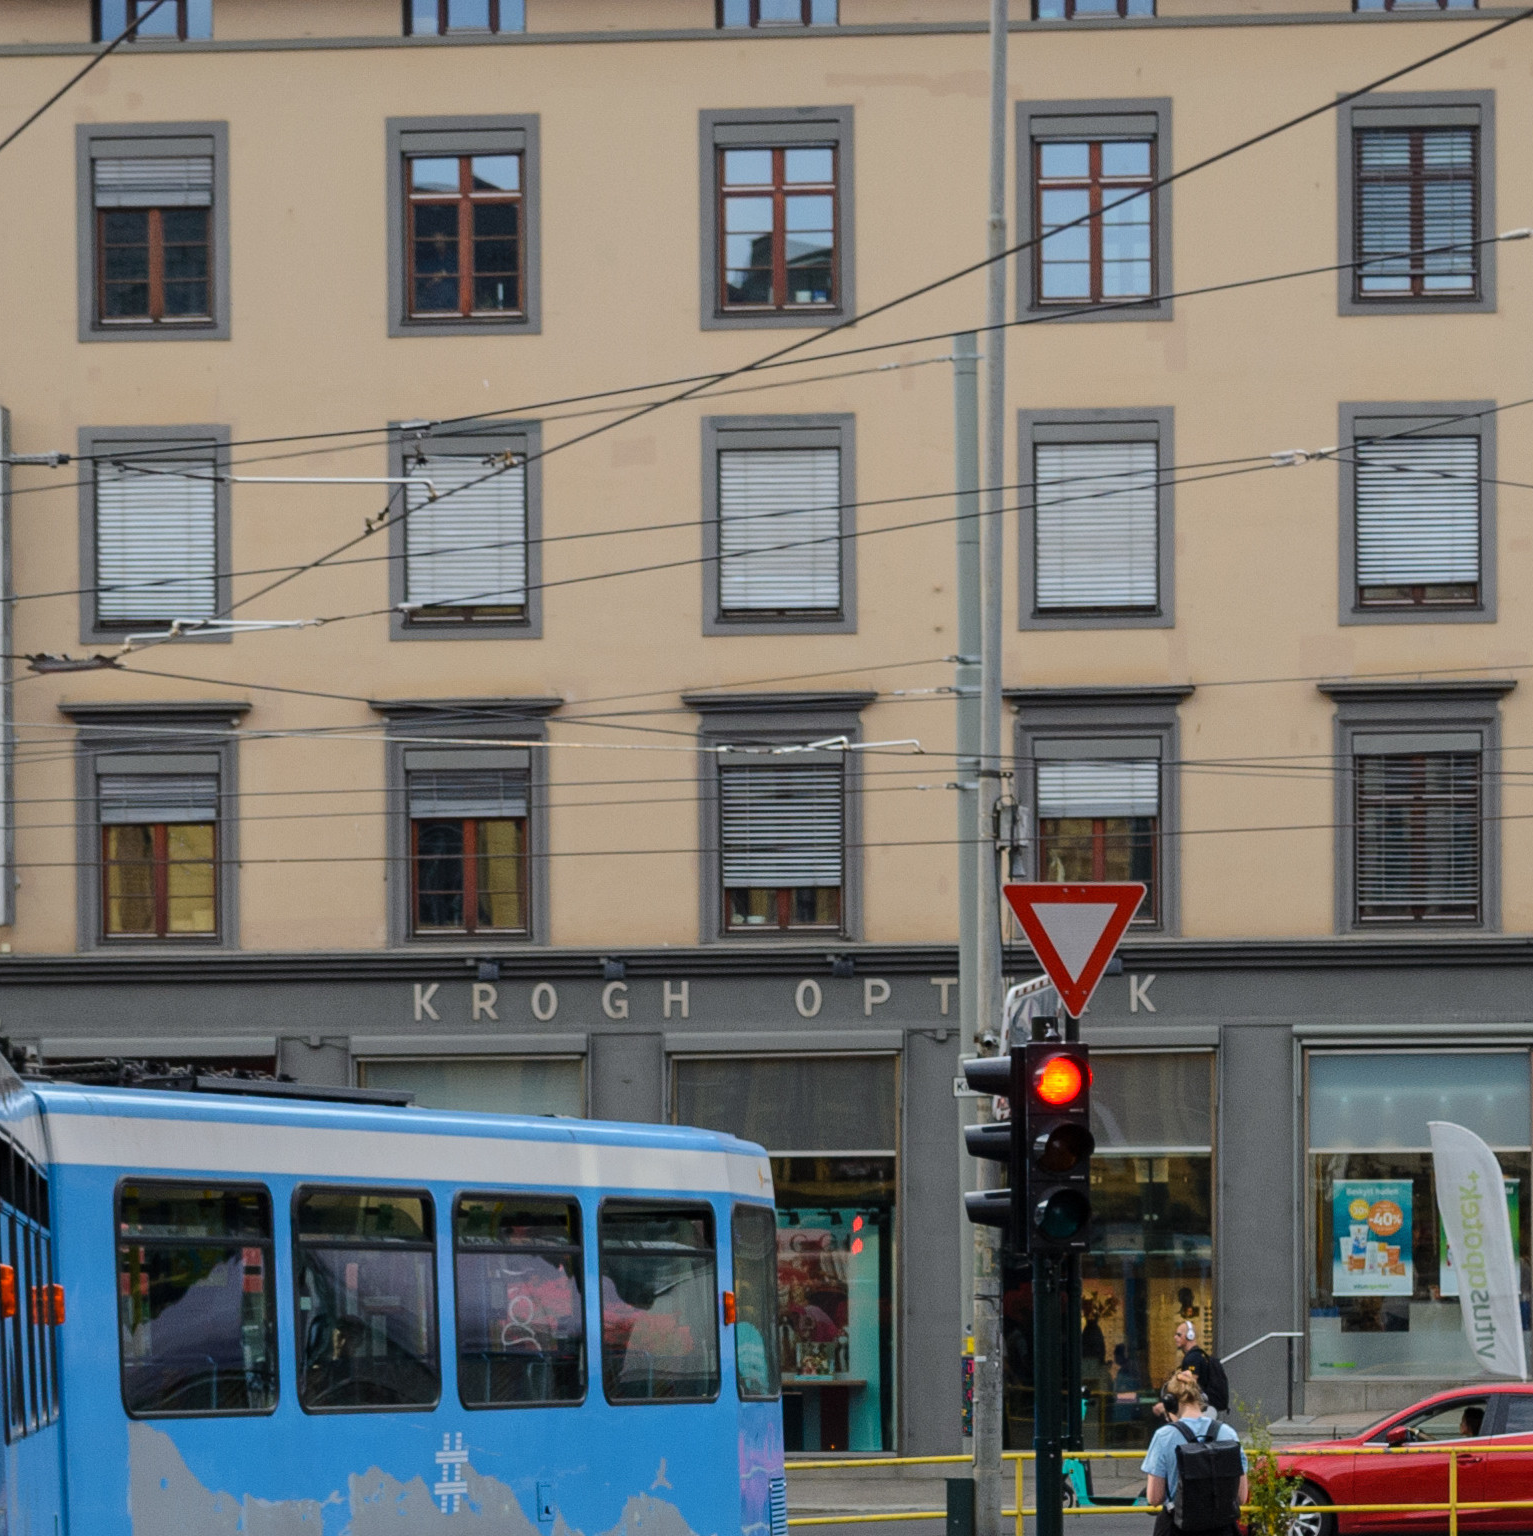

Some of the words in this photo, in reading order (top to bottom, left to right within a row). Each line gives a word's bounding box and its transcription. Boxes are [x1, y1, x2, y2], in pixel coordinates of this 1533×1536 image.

[413, 980, 690, 1021] KROGH
[795, 974, 1157, 1018] OPTK
[1369, 1212, 1403, 1226] -40%
